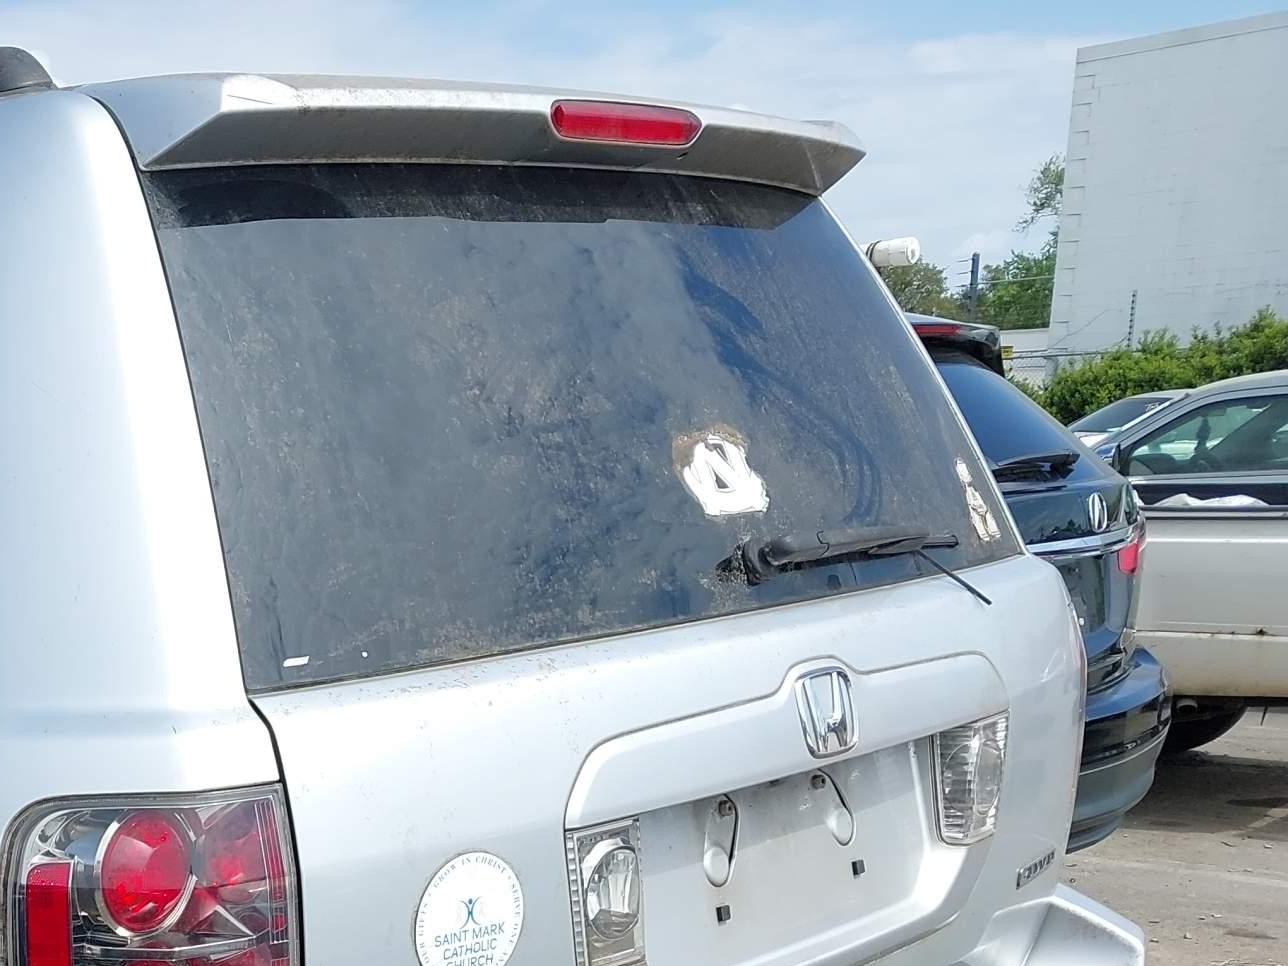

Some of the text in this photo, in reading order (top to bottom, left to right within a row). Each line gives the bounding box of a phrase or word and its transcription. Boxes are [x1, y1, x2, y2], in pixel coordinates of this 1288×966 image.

[475, 856, 507, 874] CHRIST
[434, 921, 505, 948] SAINT MARK
[443, 938, 498, 960] CATHOLIC
